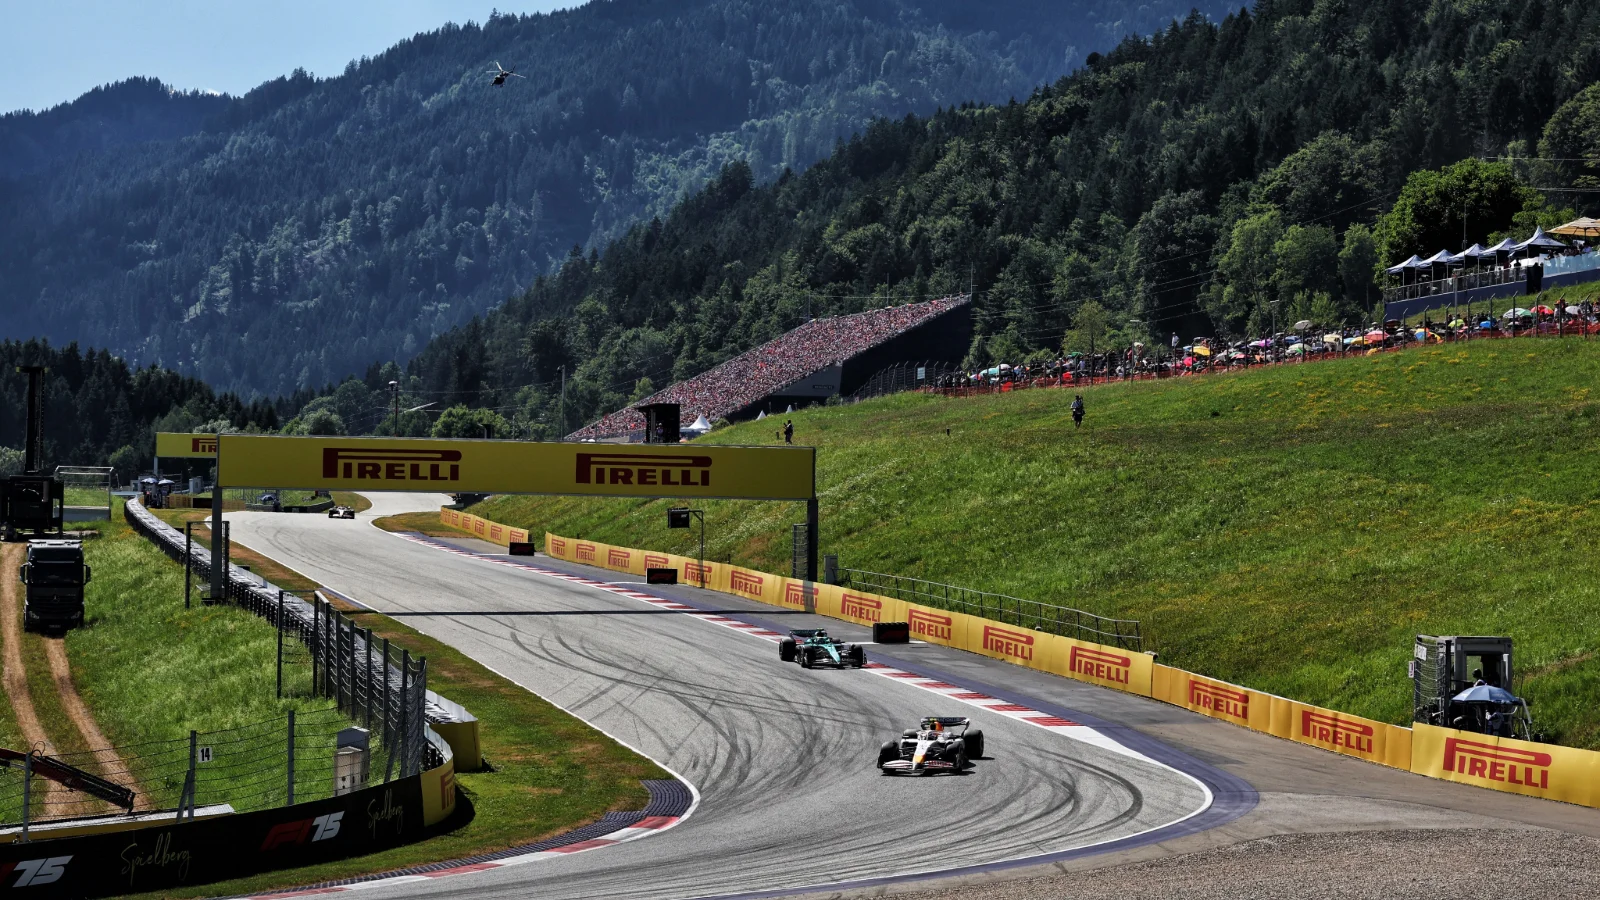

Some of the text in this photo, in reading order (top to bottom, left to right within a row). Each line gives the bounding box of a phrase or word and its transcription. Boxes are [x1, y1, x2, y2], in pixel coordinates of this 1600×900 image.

[323, 447, 462, 481] PIRELLI
[575, 452, 713, 486] PIRELLI
[576, 543, 595, 561] PIRELLI
[608, 549, 631, 568] PIRELLI
[684, 562, 713, 585] PIRELLI
[730, 570, 764, 597] PIRELLI
[785, 583, 819, 609] PIRELLI
[841, 593, 882, 622] PIRELLI
[908, 608, 952, 641] PIRELLI
[983, 625, 1034, 661] PIRELLI
[1069, 645, 1131, 685] PIRELLI
[1188, 679, 1249, 720] PIRELLI
[1302, 709, 1374, 754] PIRELLI
[200, 747, 211, 762] 14
[1443, 737, 1552, 789] PIRELLI
[367, 788, 403, 840] Spielberg
[120, 831, 193, 888] Spielberg
